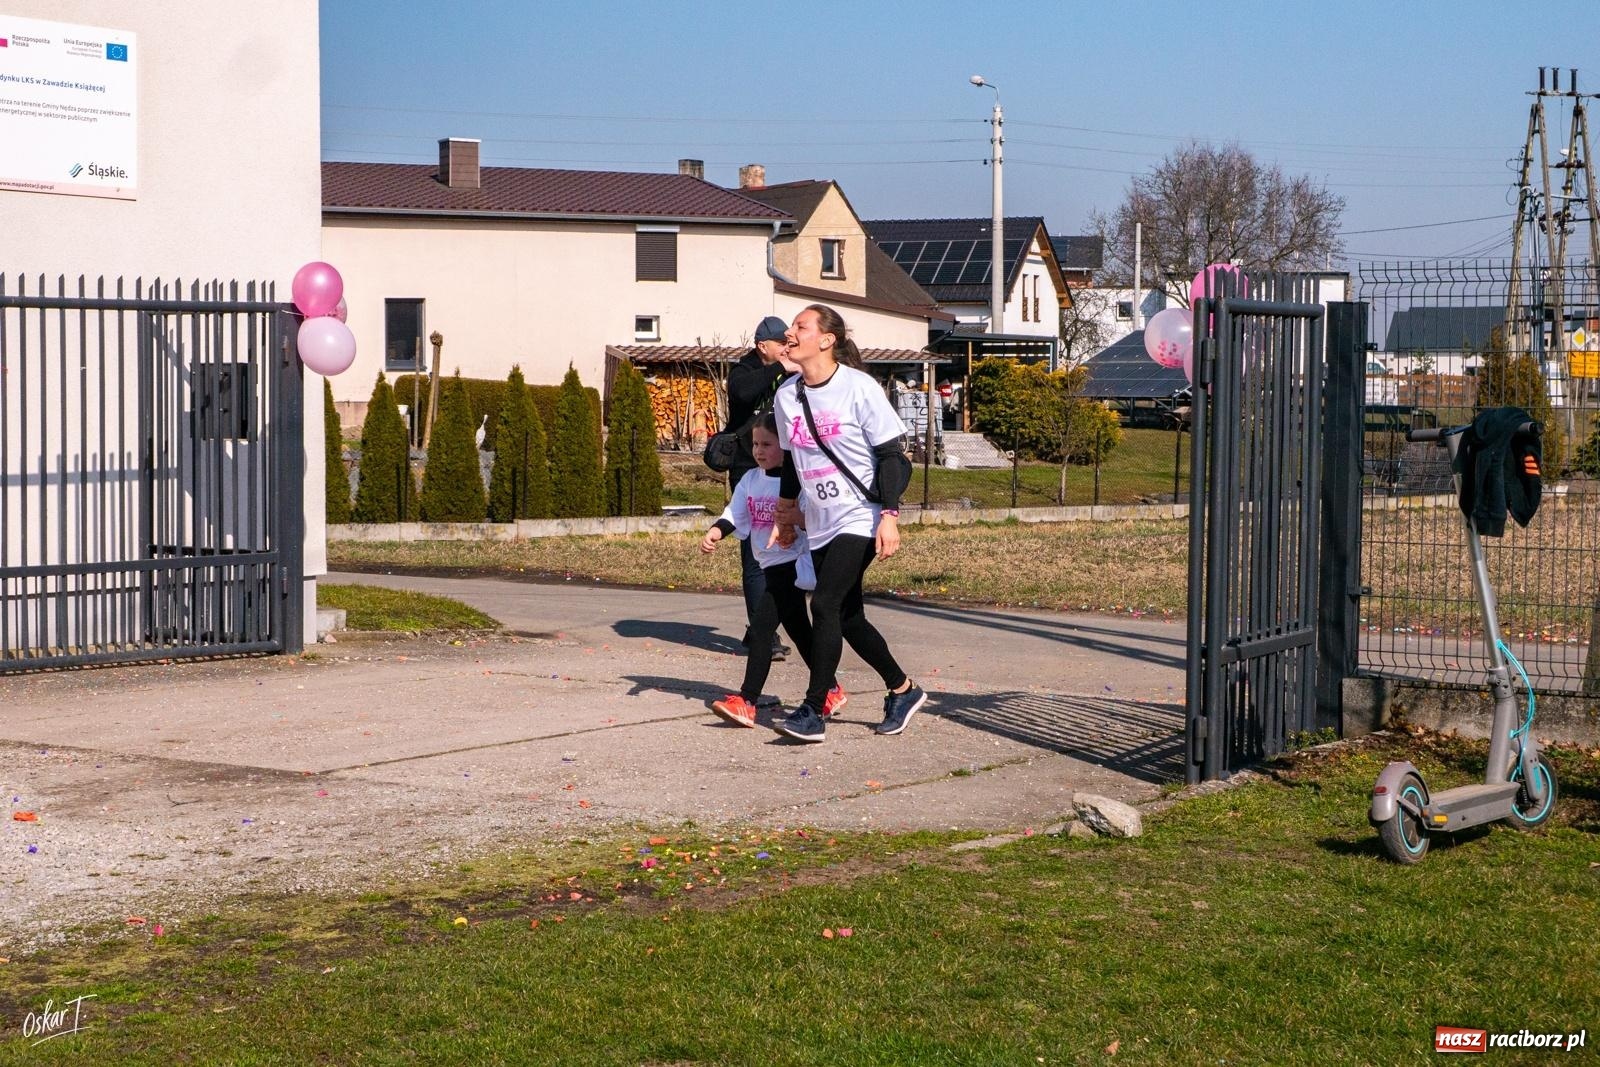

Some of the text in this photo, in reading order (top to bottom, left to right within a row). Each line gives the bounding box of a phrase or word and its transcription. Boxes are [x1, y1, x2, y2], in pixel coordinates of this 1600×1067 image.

[76, 40, 102, 48] Europejska
[21, 76, 34, 84] LKS
[42, 78, 74, 89] Zawadzie
[75, 82, 105, 93] Książęcej
[42, 102, 59, 111] Gminy
[60, 104, 77, 113] Nędza
[67, 114, 98, 123] publicznym
[88, 162, 128, 179] Śląskie.
[815, 480, 840, 500] 83
